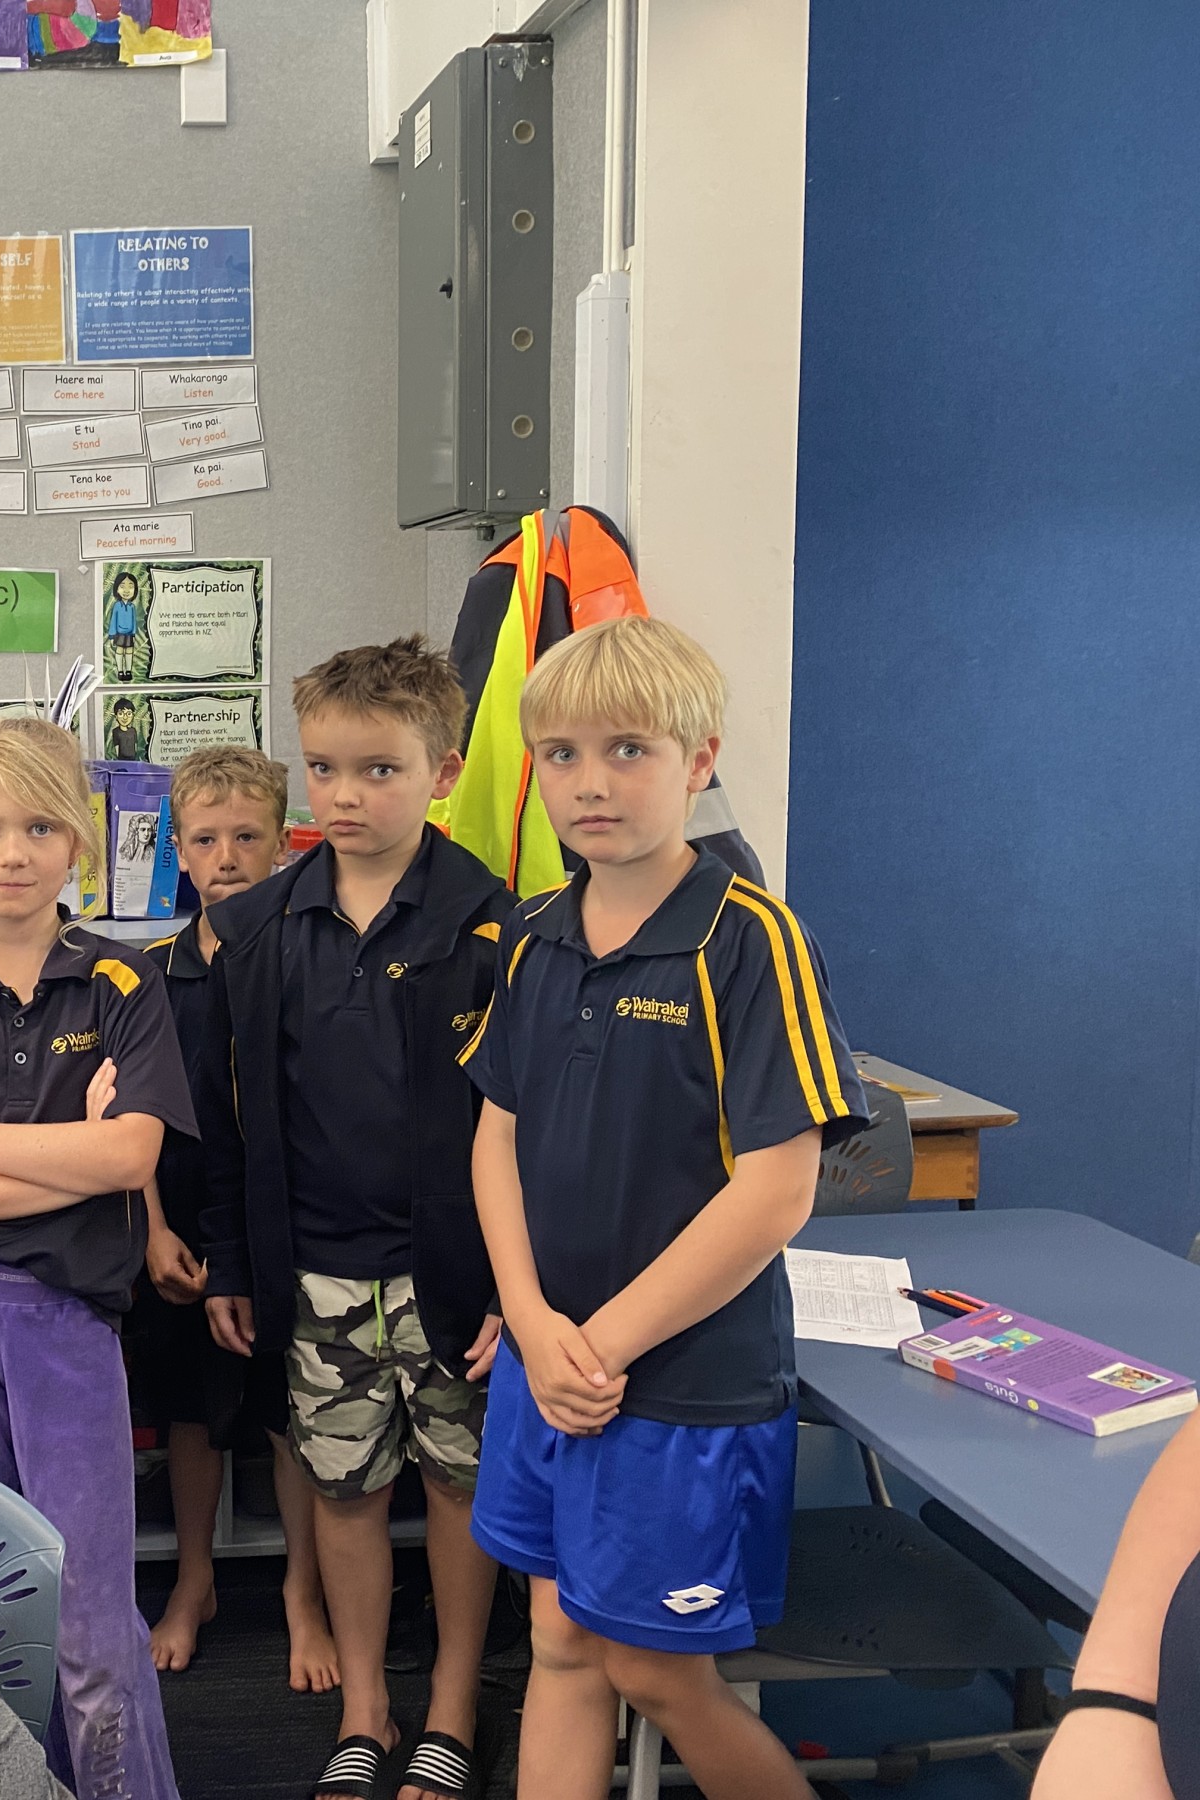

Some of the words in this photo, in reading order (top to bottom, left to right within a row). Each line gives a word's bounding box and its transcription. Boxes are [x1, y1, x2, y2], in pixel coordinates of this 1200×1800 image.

[117, 236, 187, 252] RELATING
[190, 236, 208, 250] TO
[0, 252, 32, 266] SELF
[138, 257, 190, 272] OTHERS
[55, 375, 84, 384] Haere
[87, 375, 104, 384] mai
[169, 374, 228, 384] Whakarongo
[54, 390, 79, 399] Come
[82, 390, 104, 399] here
[183, 389, 214, 398] Listen
[75, 425, 81, 435] E
[84, 426, 95, 434] tu
[182, 421, 203, 431] Tino
[205, 416, 222, 429] pai.
[72, 438, 100, 450] Stand
[178, 435, 201, 447] Very
[204, 430, 230, 444] good.
[193, 465, 205, 475] Ka
[207, 462, 224, 474] pai.
[70, 474, 93, 484] Tena
[95, 473, 112, 483] koe
[197, 477, 224, 489] Good.
[52, 489, 98, 500] Greetings
[114, 488, 131, 499] you
[113, 523, 131, 533] Ata
[133, 522, 160, 531] marie
[96, 538, 137, 549] Peaceful
[139, 536, 177, 546] morning
[162, 580, 244, 596] Participation
[164, 708, 241, 724] Partnership
[632, 996, 690, 1018] Wairakei
[632, 1011, 661, 1021] PRIMARY
[662, 1015, 687, 1026] SCHOOL
[984, 1382, 1019, 1404] Guts
